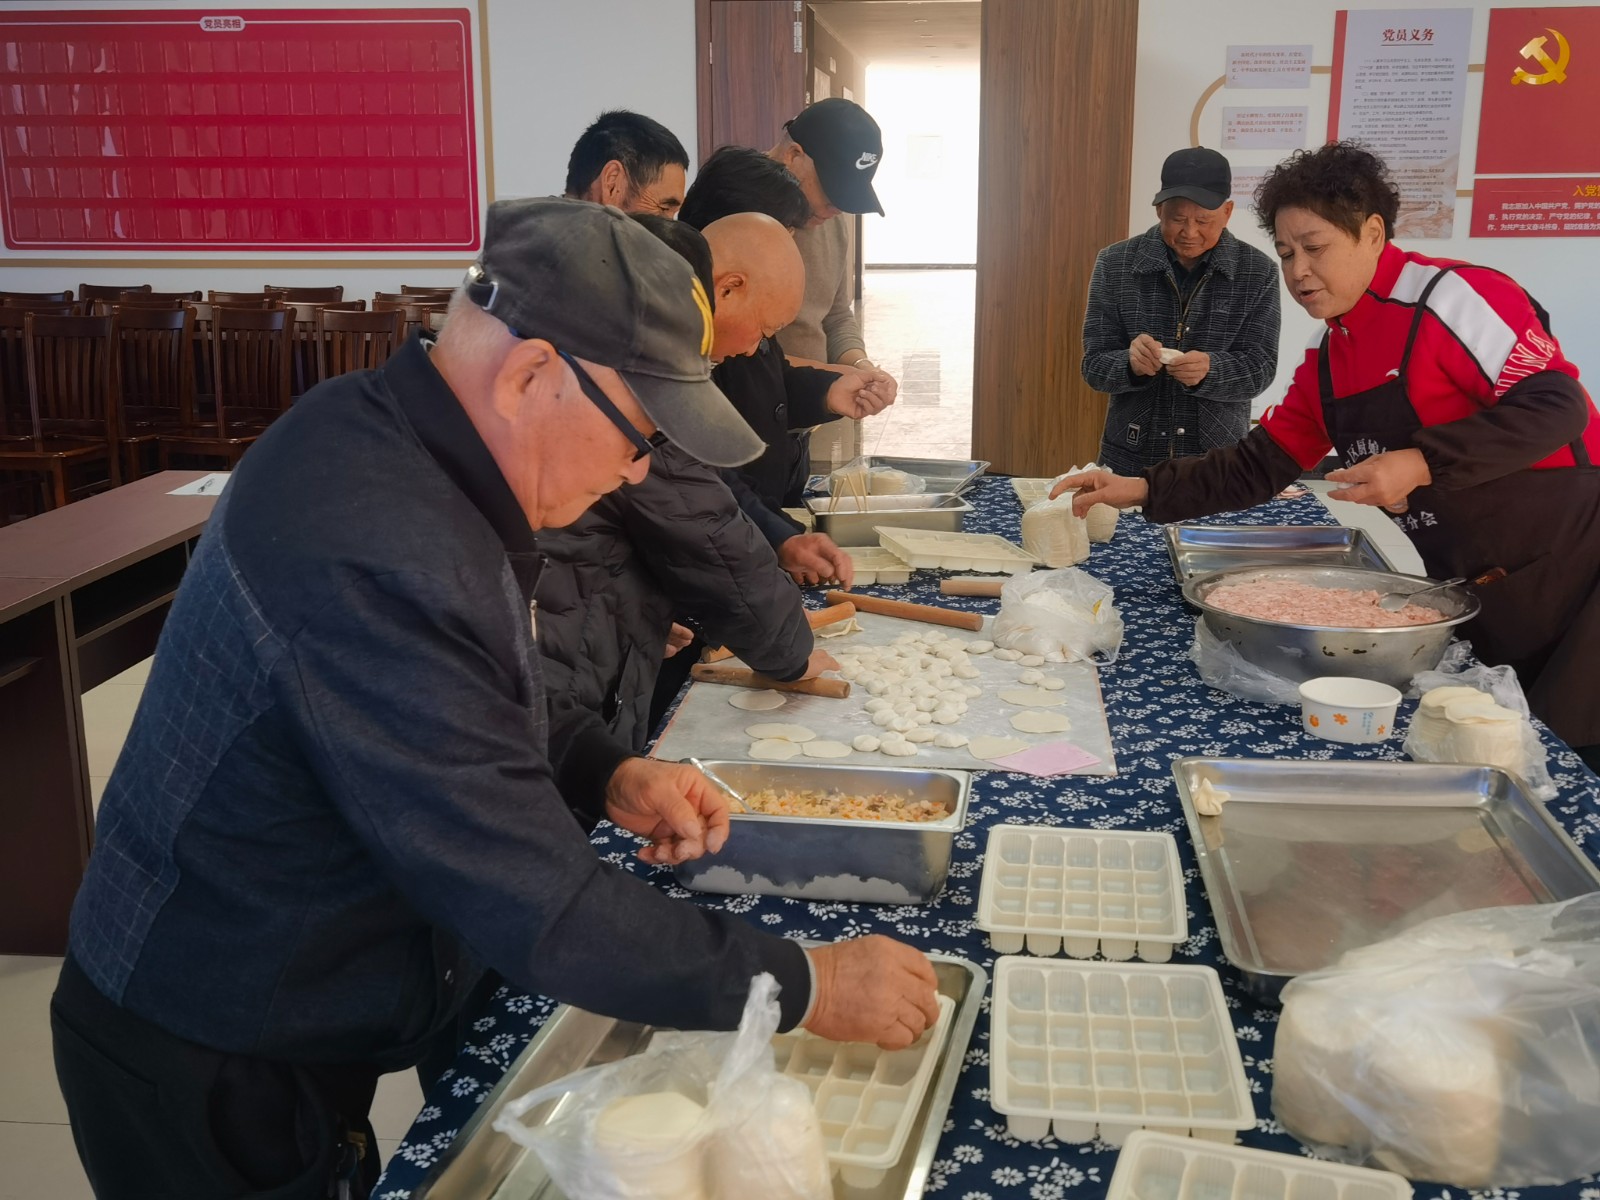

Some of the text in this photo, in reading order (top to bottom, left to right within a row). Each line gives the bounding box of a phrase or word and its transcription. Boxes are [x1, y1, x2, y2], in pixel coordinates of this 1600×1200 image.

[204, 19, 241, 29] 党员亮相
[1382, 28, 1435, 42] 党员义务
[862, 151, 878, 163] NIKE
[1572, 184, 1600, 197] 入党
